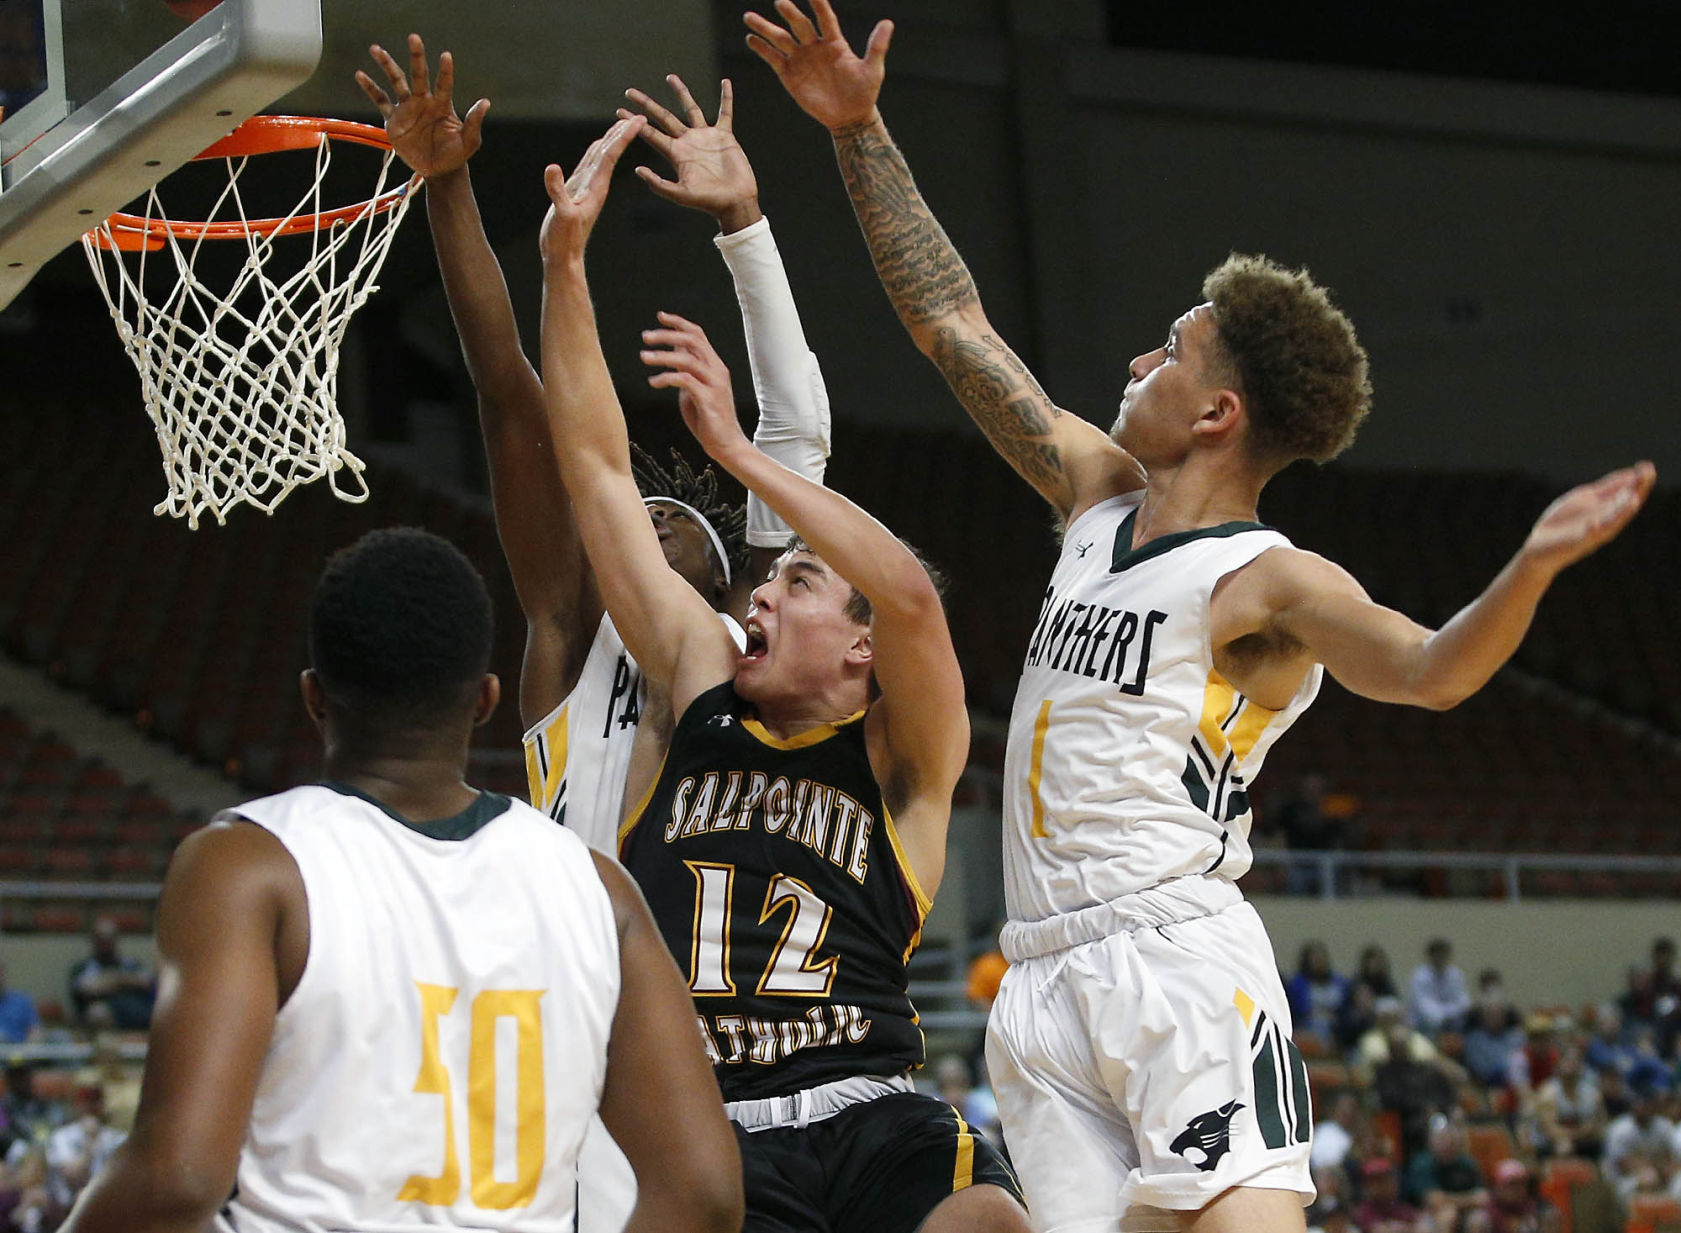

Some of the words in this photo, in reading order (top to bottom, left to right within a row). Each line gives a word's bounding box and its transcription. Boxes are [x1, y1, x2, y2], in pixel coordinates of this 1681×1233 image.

[664, 771, 874, 885] SALPOINTE
[683, 860, 841, 997] 12
[395, 980, 549, 1211] 50
[697, 1004, 872, 1065] ATHOLIC
